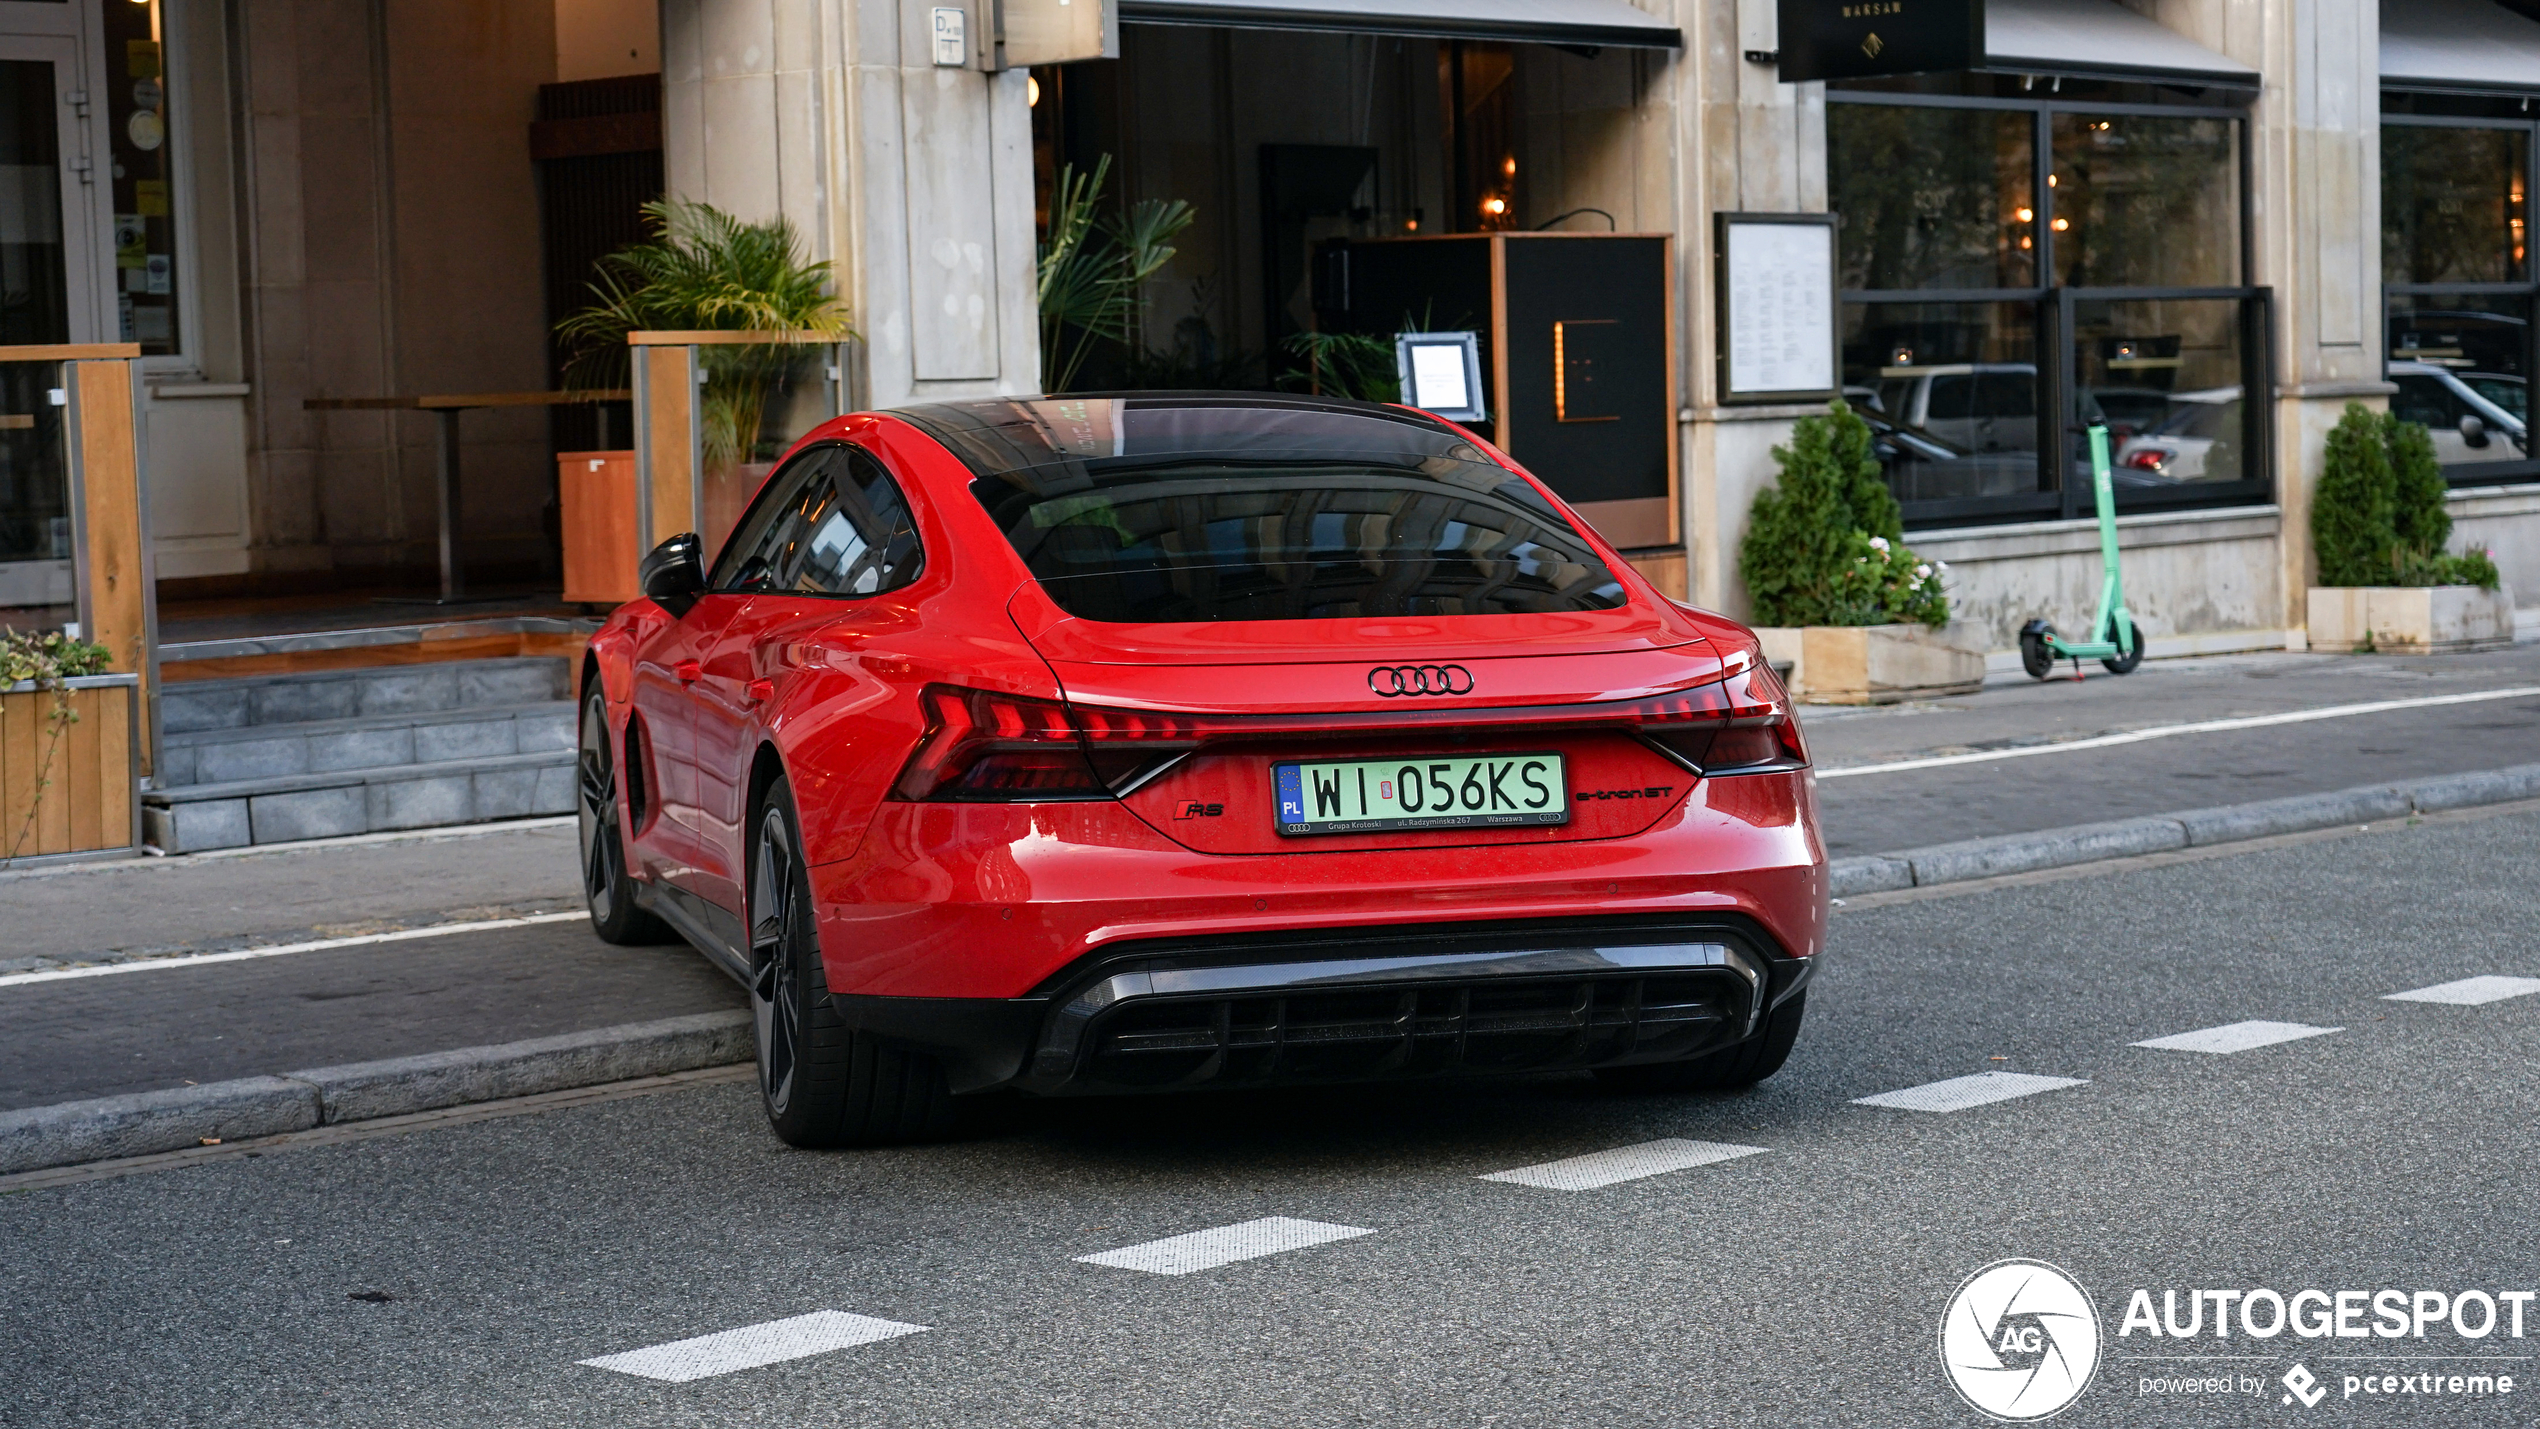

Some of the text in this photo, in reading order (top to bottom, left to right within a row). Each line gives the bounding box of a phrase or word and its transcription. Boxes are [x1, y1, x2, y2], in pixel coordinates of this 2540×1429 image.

[1842, 1, 1902, 18] WARSAW
[1311, 760, 1550, 817] WI 056KS
[1576, 786, 1674, 801] e-tron GT
[1185, 803, 1224, 817] RS
[1283, 801, 1301, 815] PL
[1328, 822, 1350, 831] Grupa
[1351, 820, 1382, 829] Krotoski
[1409, 817, 1455, 827] Radzymińska
[1456, 816, 1471, 824] 267
[1487, 815, 1523, 823] Warszawa
